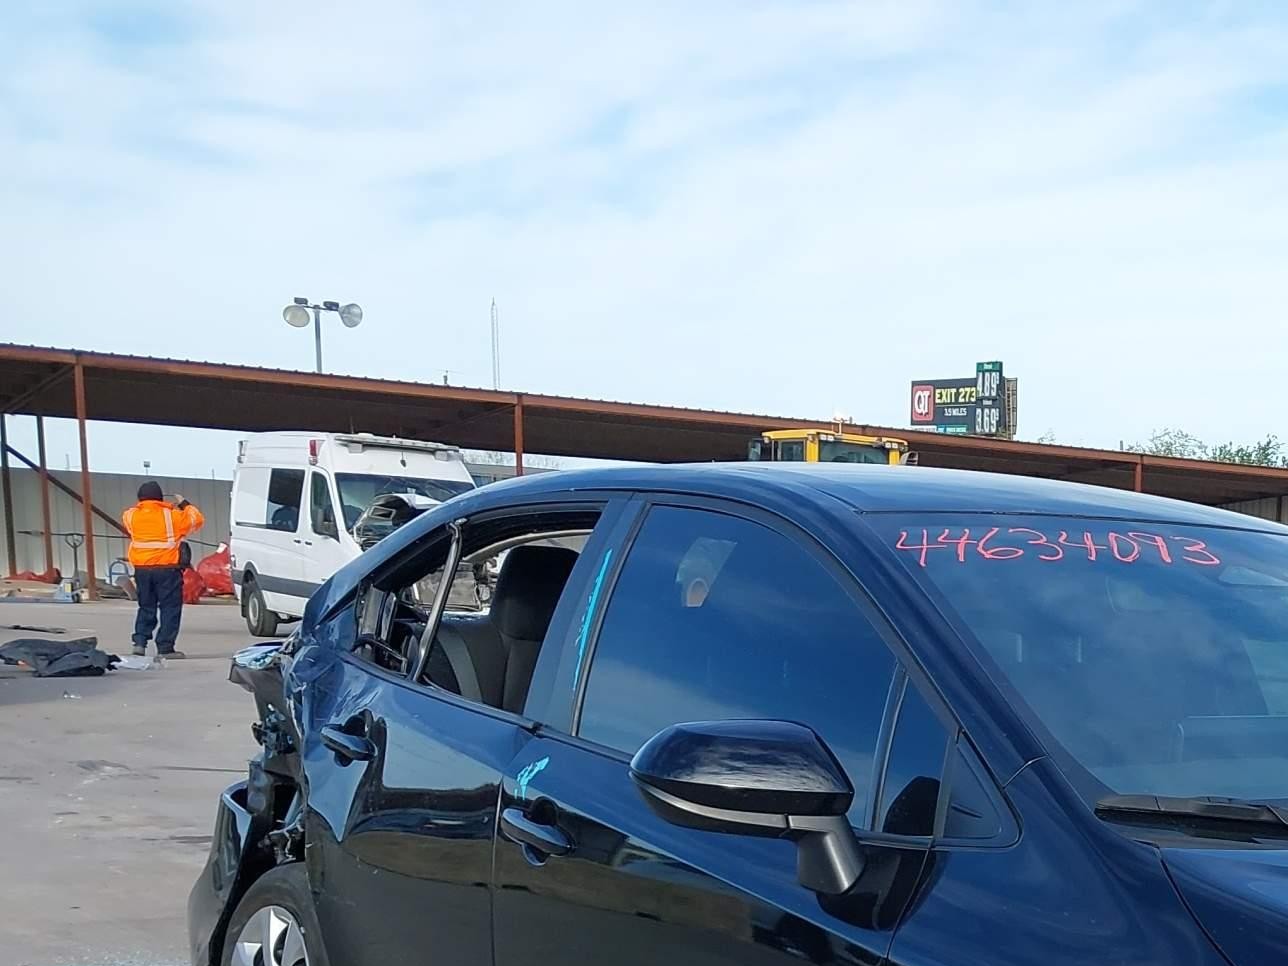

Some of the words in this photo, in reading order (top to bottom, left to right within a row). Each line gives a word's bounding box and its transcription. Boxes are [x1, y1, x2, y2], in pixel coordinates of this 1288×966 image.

[914, 391, 931, 416] QT
[935, 389, 957, 403] EXIT
[959, 388, 976, 402] 273
[952, 407, 967, 416] MILES
[896, 527, 1221, 567] 44634093
